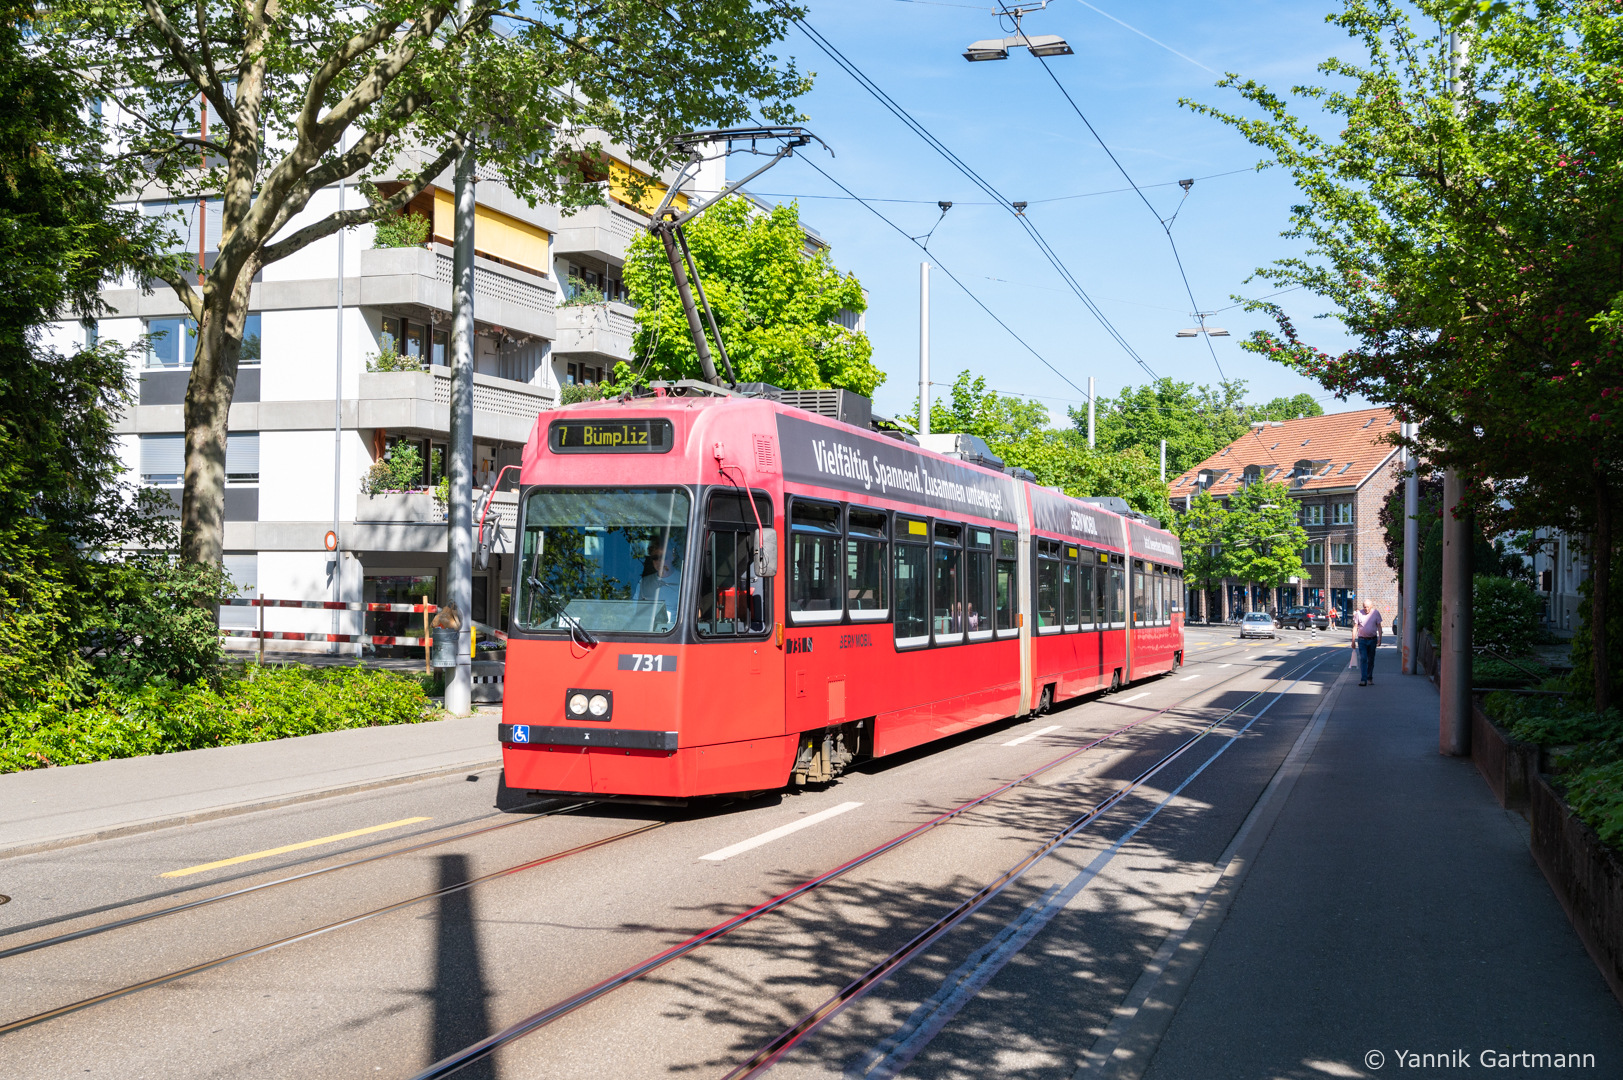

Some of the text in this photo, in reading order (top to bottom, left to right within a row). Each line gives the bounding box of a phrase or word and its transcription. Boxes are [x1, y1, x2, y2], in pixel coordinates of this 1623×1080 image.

[559, 425, 648, 447] 7 Bümpliz
[812, 439, 1004, 517] Vielfältig. Spannend. Zusammen unterwegs!
[632, 654, 663, 672] 731
